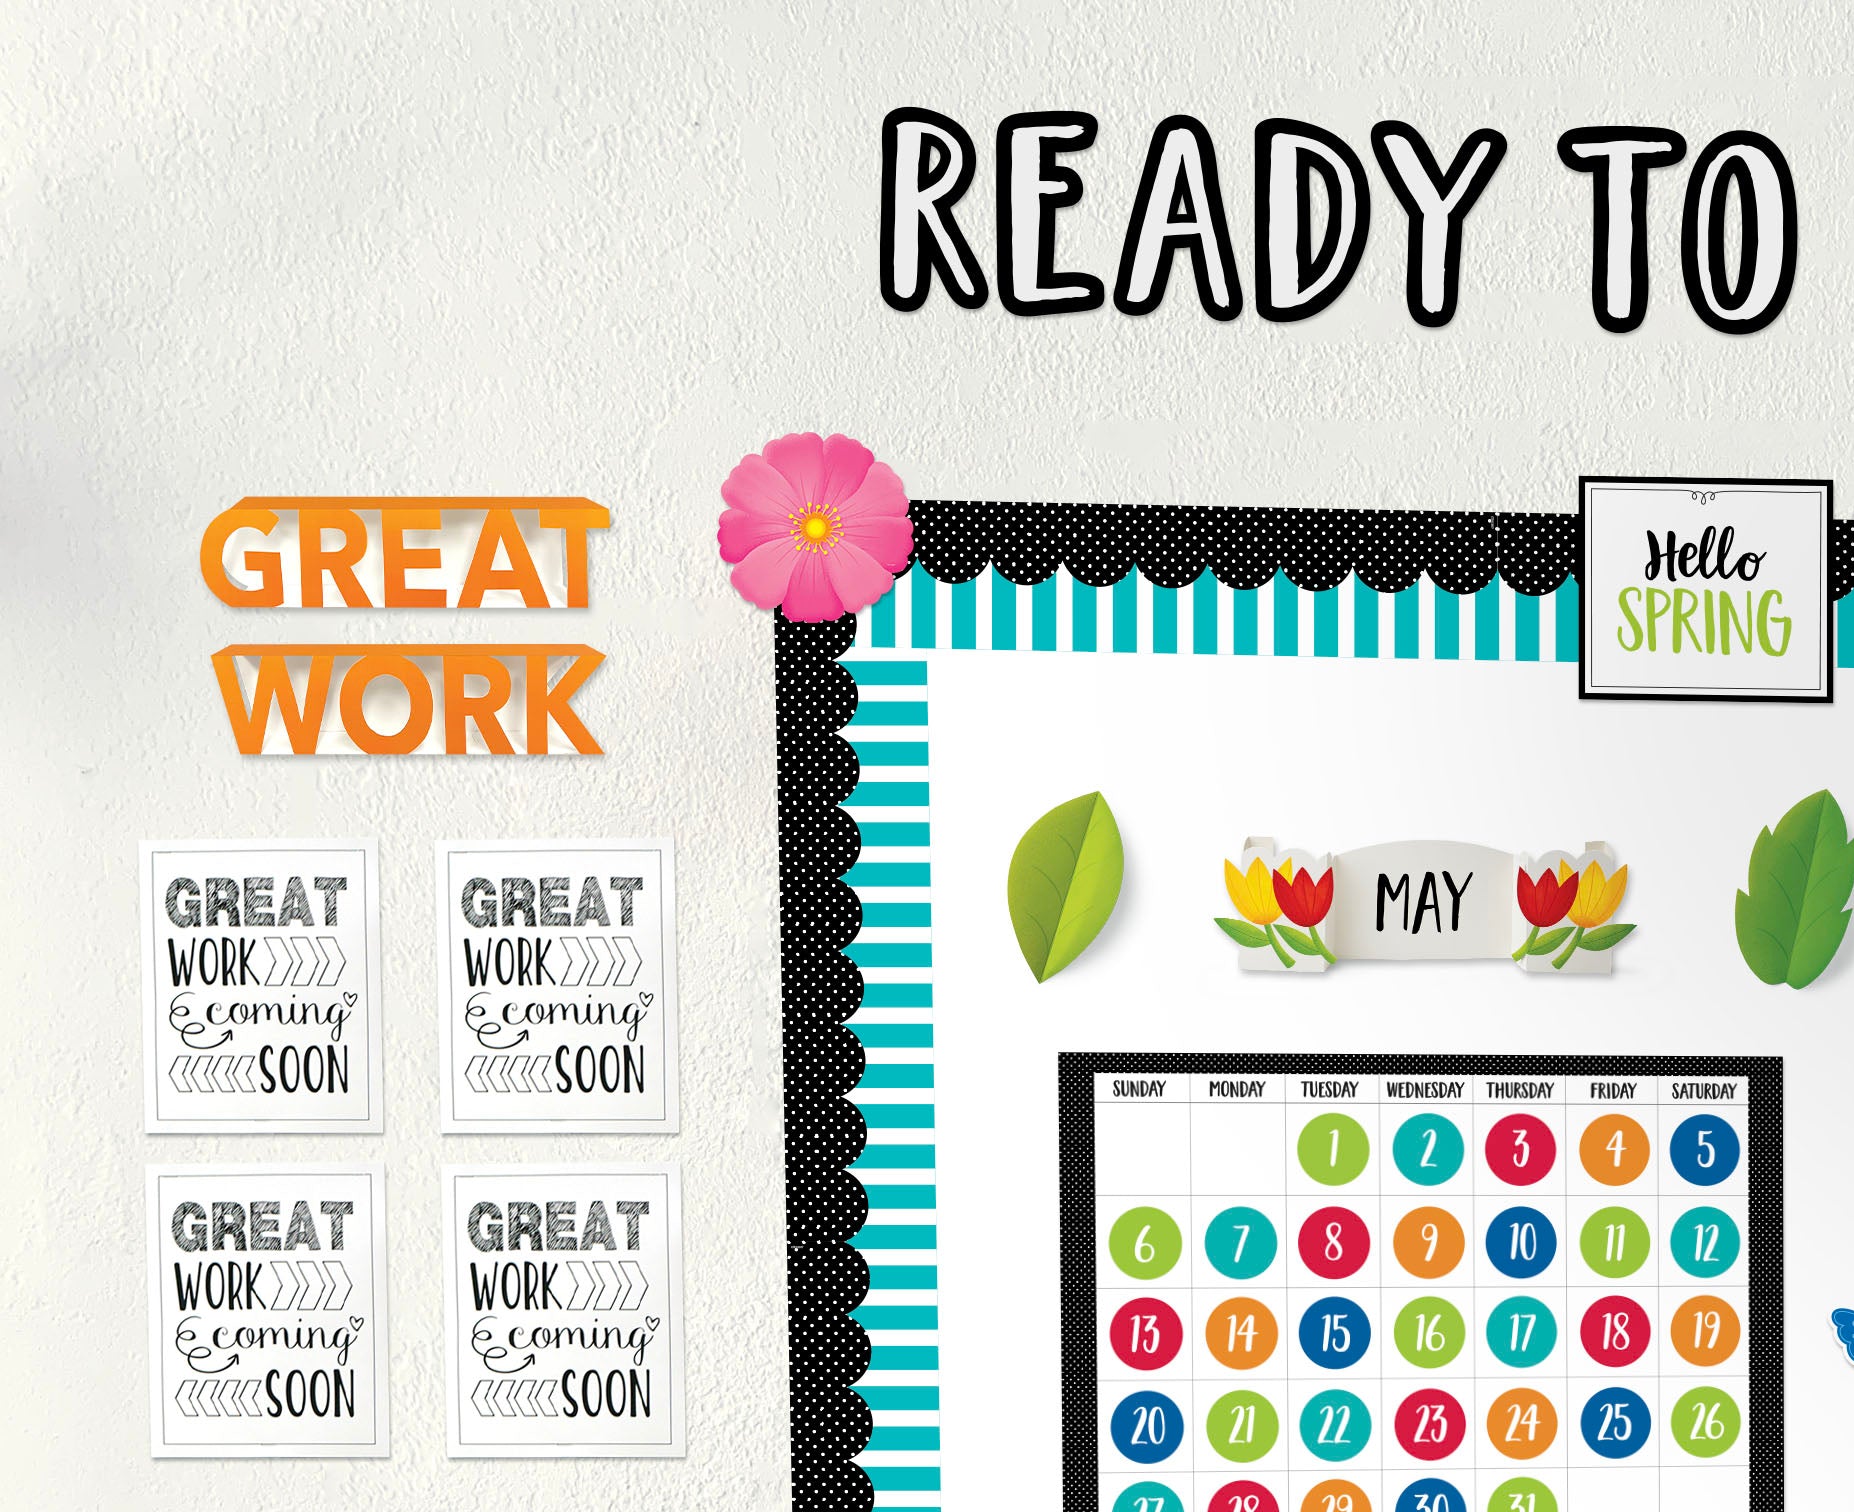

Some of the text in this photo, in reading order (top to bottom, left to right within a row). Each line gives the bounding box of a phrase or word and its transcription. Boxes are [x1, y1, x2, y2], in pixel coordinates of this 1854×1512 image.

[880, 106, 1508, 328] READY
[1557, 125, 1799, 335] TO
[200, 496, 611, 608] GREAT
[1645, 526, 1767, 582] Hello
[1618, 587, 1791, 656] SPRING
[211, 644, 606, 755] WORK
[165, 877, 347, 928] GREAT
[461, 877, 643, 928] GREAT
[1376, 871, 1473, 934] MAY
[168, 937, 260, 987] WORK
[464, 937, 556, 987] WORK
[206, 994, 351, 1042] coming
[502, 994, 647, 1042] coming
[260, 1044, 349, 1094] SOON
[556, 1044, 645, 1094] SOON
[1113, 1080, 1737, 1099] SUNDAY MONDAY TUESDAY WEDNESDAY THURSDAY FRIDAY SATURDAY
[1331, 1130, 1714, 1167] 1 2 3 4 5
[172, 1201, 353, 1252] GREAT
[468, 1201, 649, 1252] GREAT
[1135, 1223, 1718, 1262] 6 7 8 9 10 11 12
[174, 1262, 266, 1311] WORK
[470, 1262, 562, 1311] WORK
[212, 1318, 356, 1365] coming
[508, 1318, 653, 1365] coming
[1132, 1312, 1720, 1353] 13 14 15 16 17 18 19
[266, 1369, 354, 1418] SOON
[562, 1369, 650, 1418] SOON
[1132, 1403, 1724, 1444] 20 21 22 23 24 25 26
